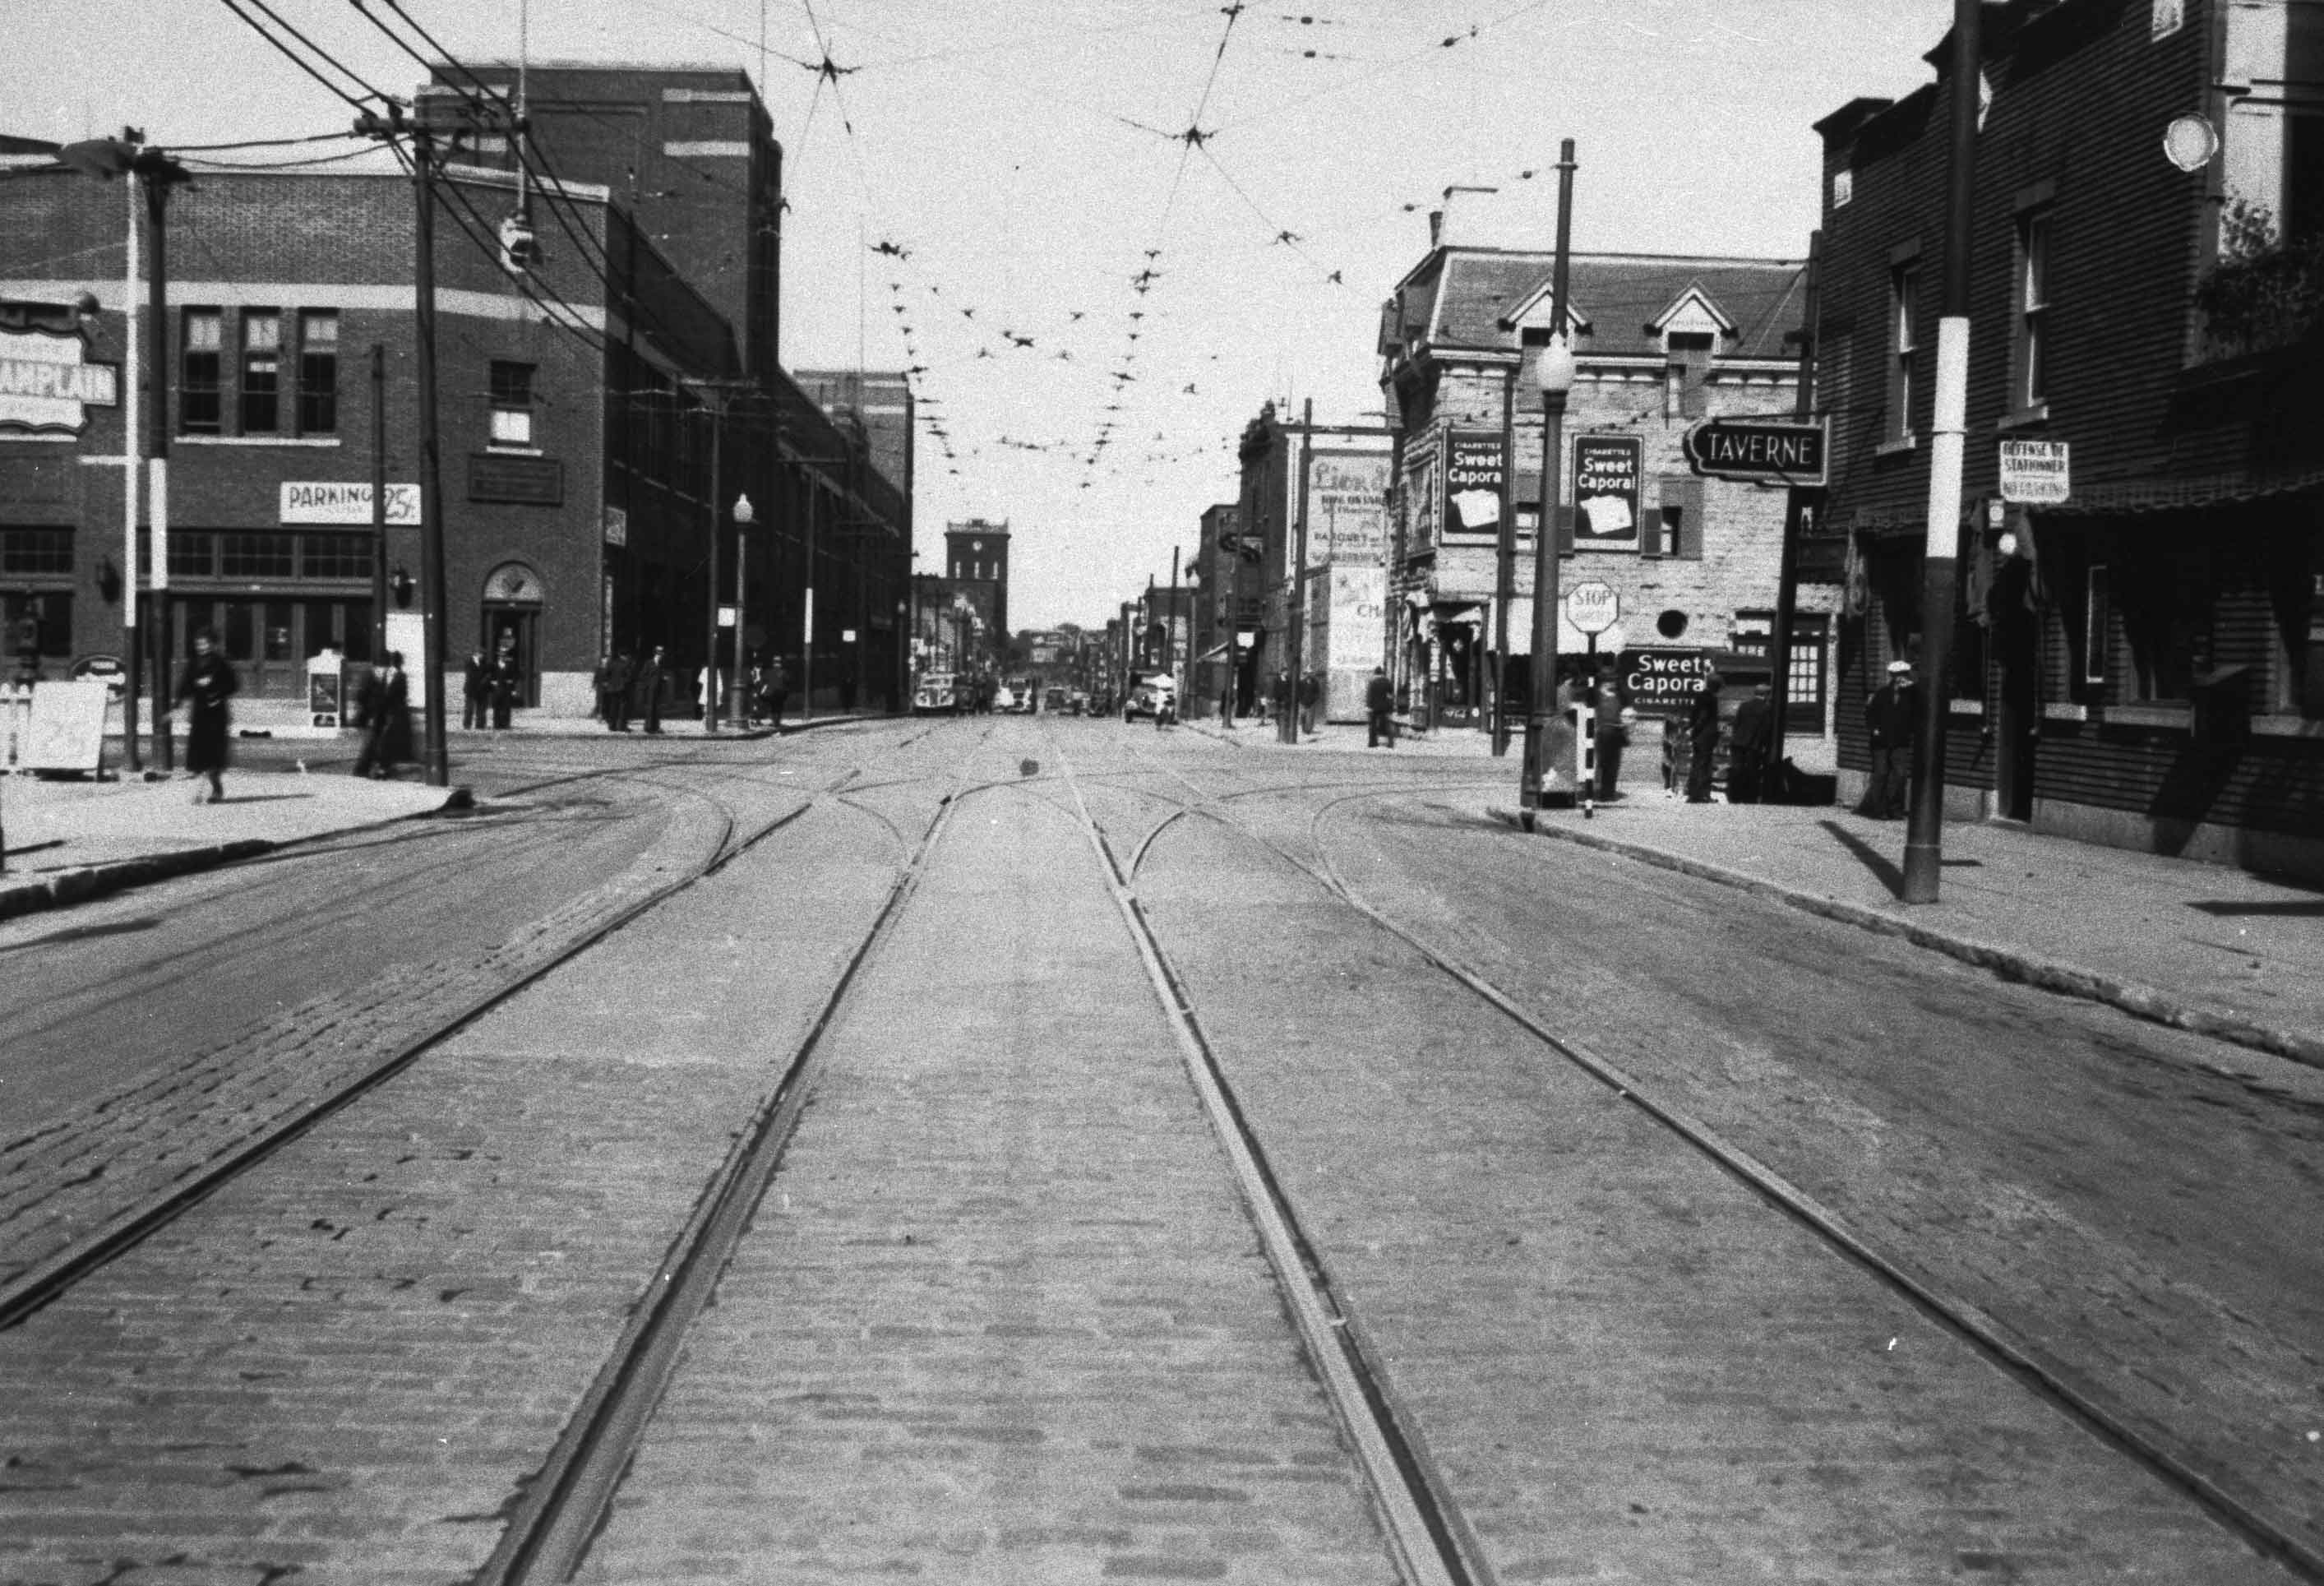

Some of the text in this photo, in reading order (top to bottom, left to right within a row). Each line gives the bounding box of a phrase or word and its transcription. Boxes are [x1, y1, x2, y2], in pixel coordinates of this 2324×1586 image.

[1707, 433, 1813, 467] TAVERNE
[1454, 451, 1503, 467] Sweet
[1584, 457, 1633, 473] Sweet
[1448, 468, 1503, 485] Capora
[1578, 473, 1637, 491] Caporal
[1575, 590, 1612, 605] STOP
[1627, 673, 1706, 695] Capora
